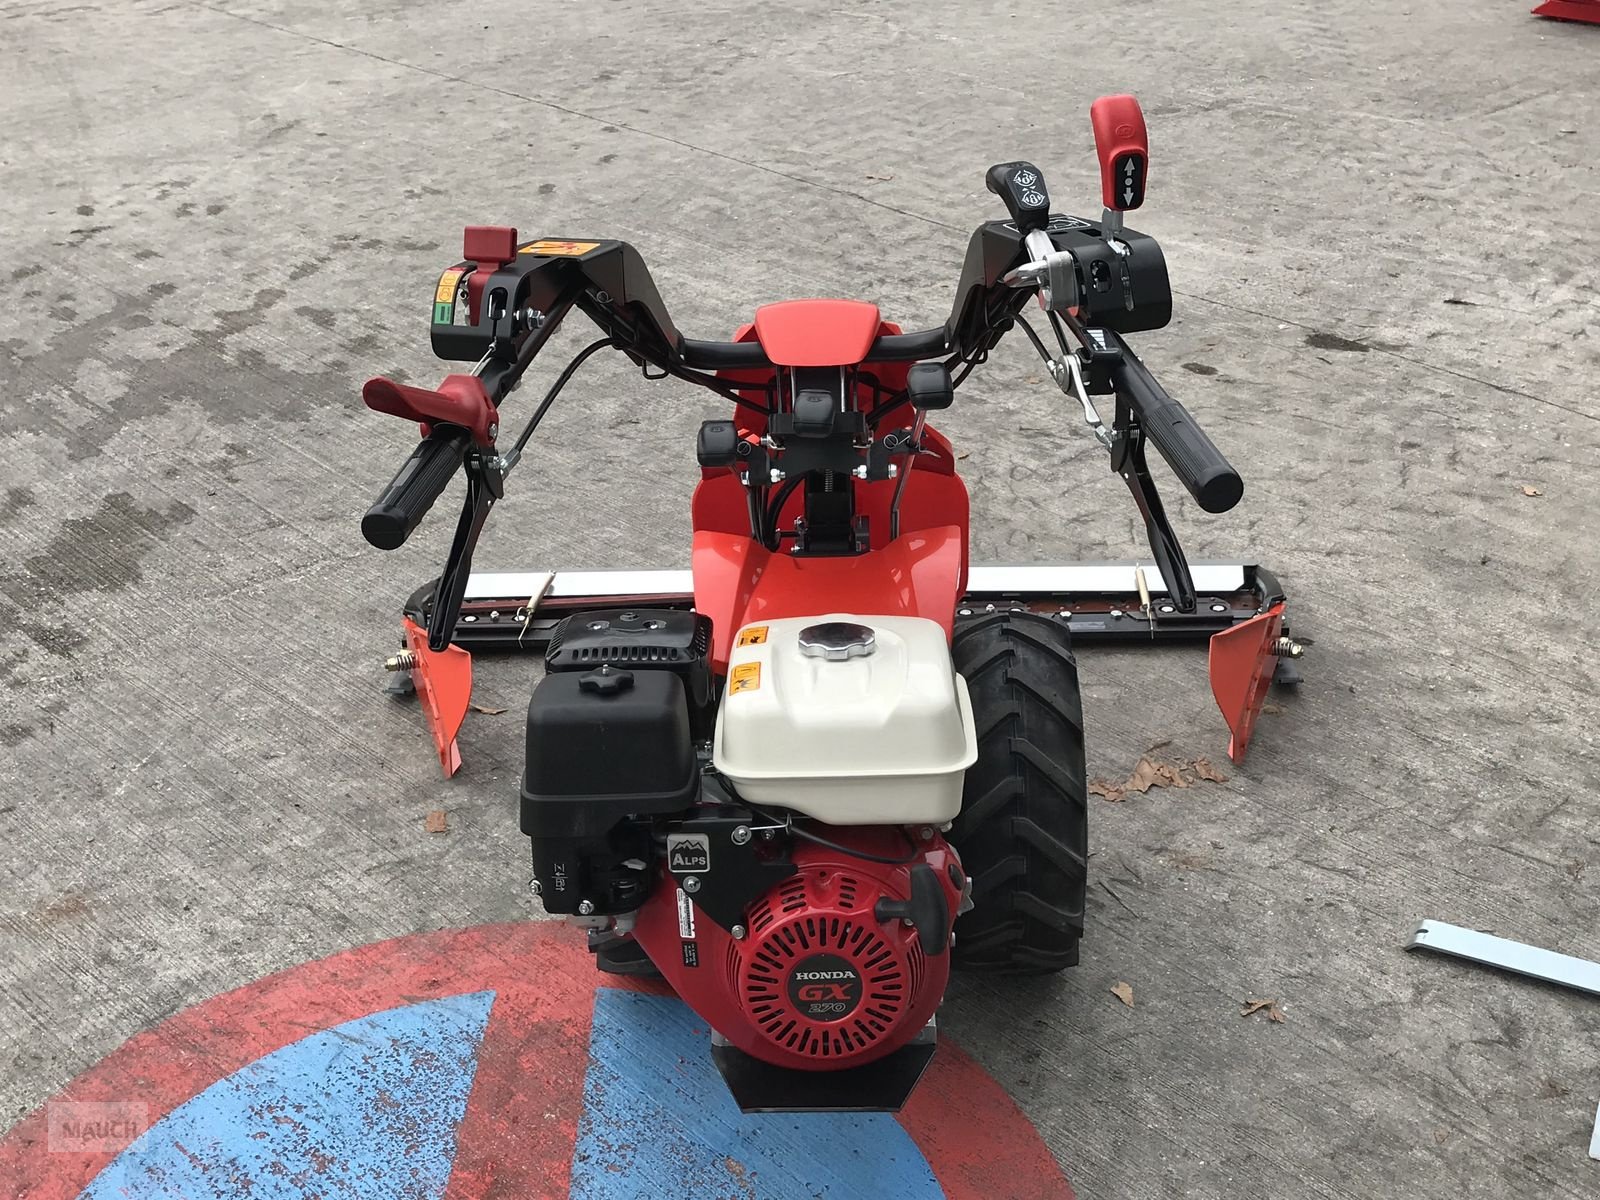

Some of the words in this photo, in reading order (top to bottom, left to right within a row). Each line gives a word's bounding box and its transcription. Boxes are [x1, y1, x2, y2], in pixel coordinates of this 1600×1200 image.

[796, 971, 856, 980] HONDA
[799, 983, 853, 1001] GX
[808, 1003, 846, 1013] 270
